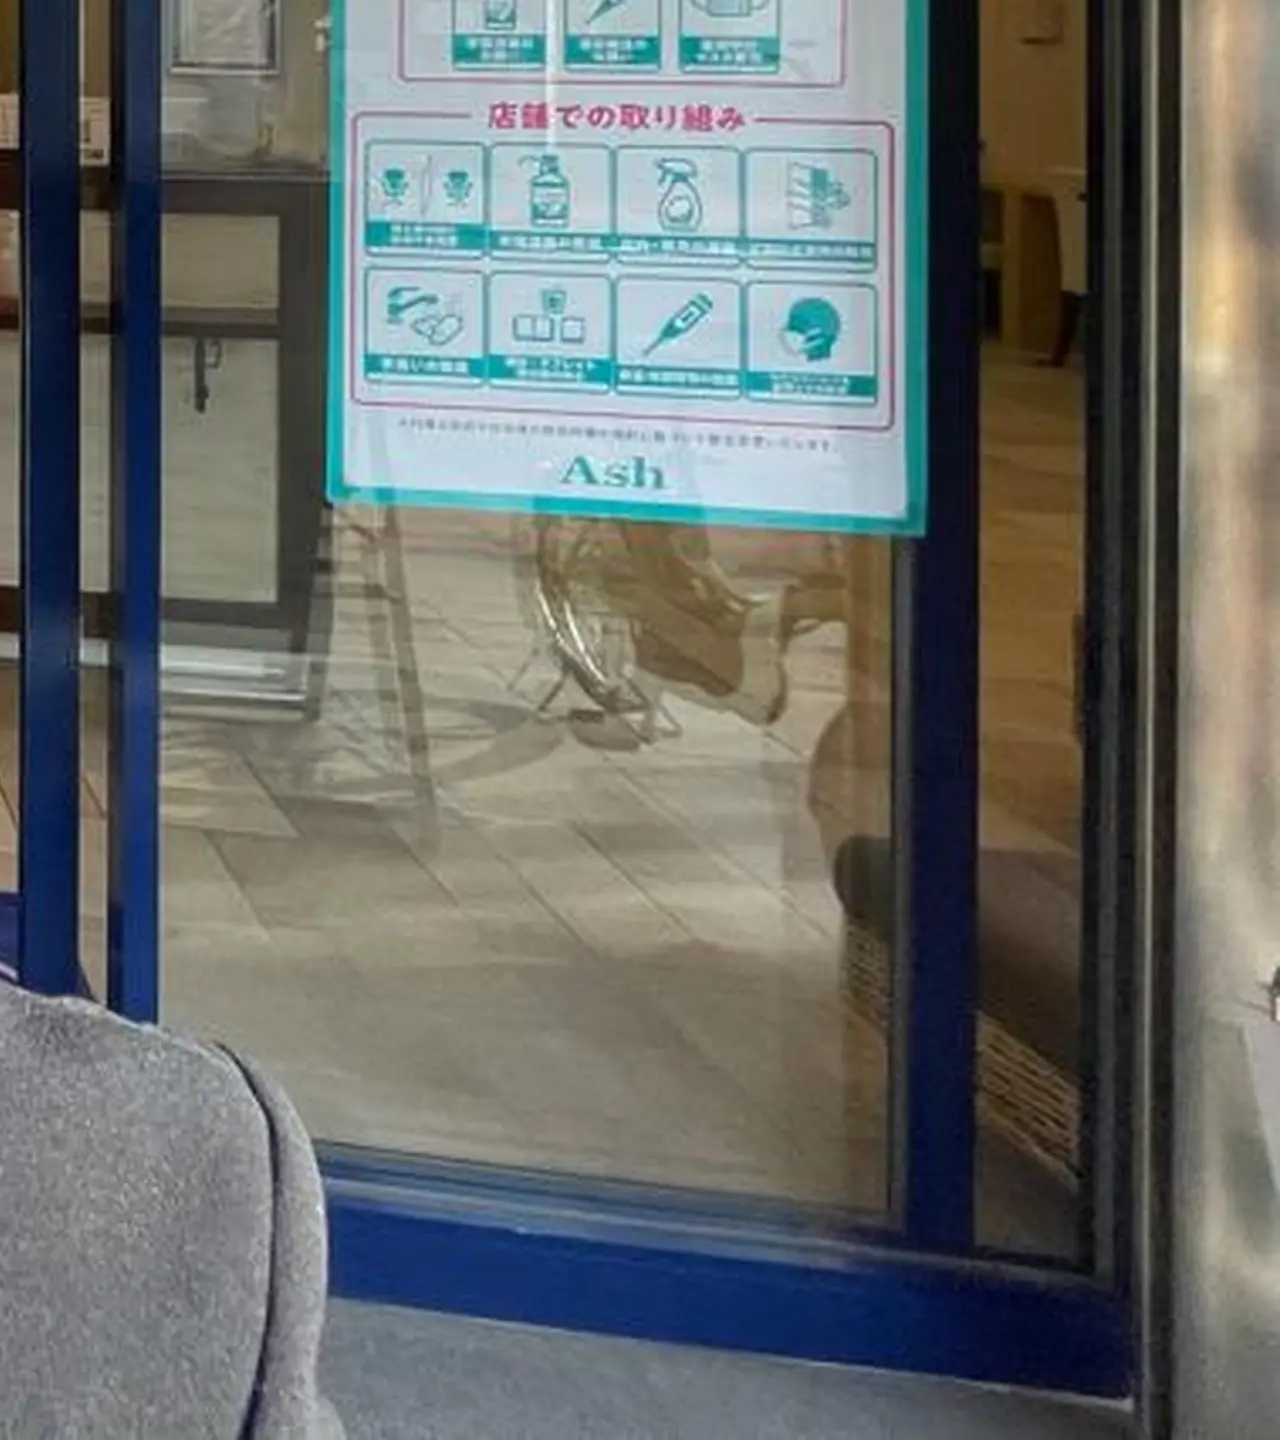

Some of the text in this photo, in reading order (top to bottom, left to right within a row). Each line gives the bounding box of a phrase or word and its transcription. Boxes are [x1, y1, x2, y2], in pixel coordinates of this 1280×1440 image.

[488, 102, 744, 131] 店舗での取り組み
[560, 456, 665, 491] Ash
